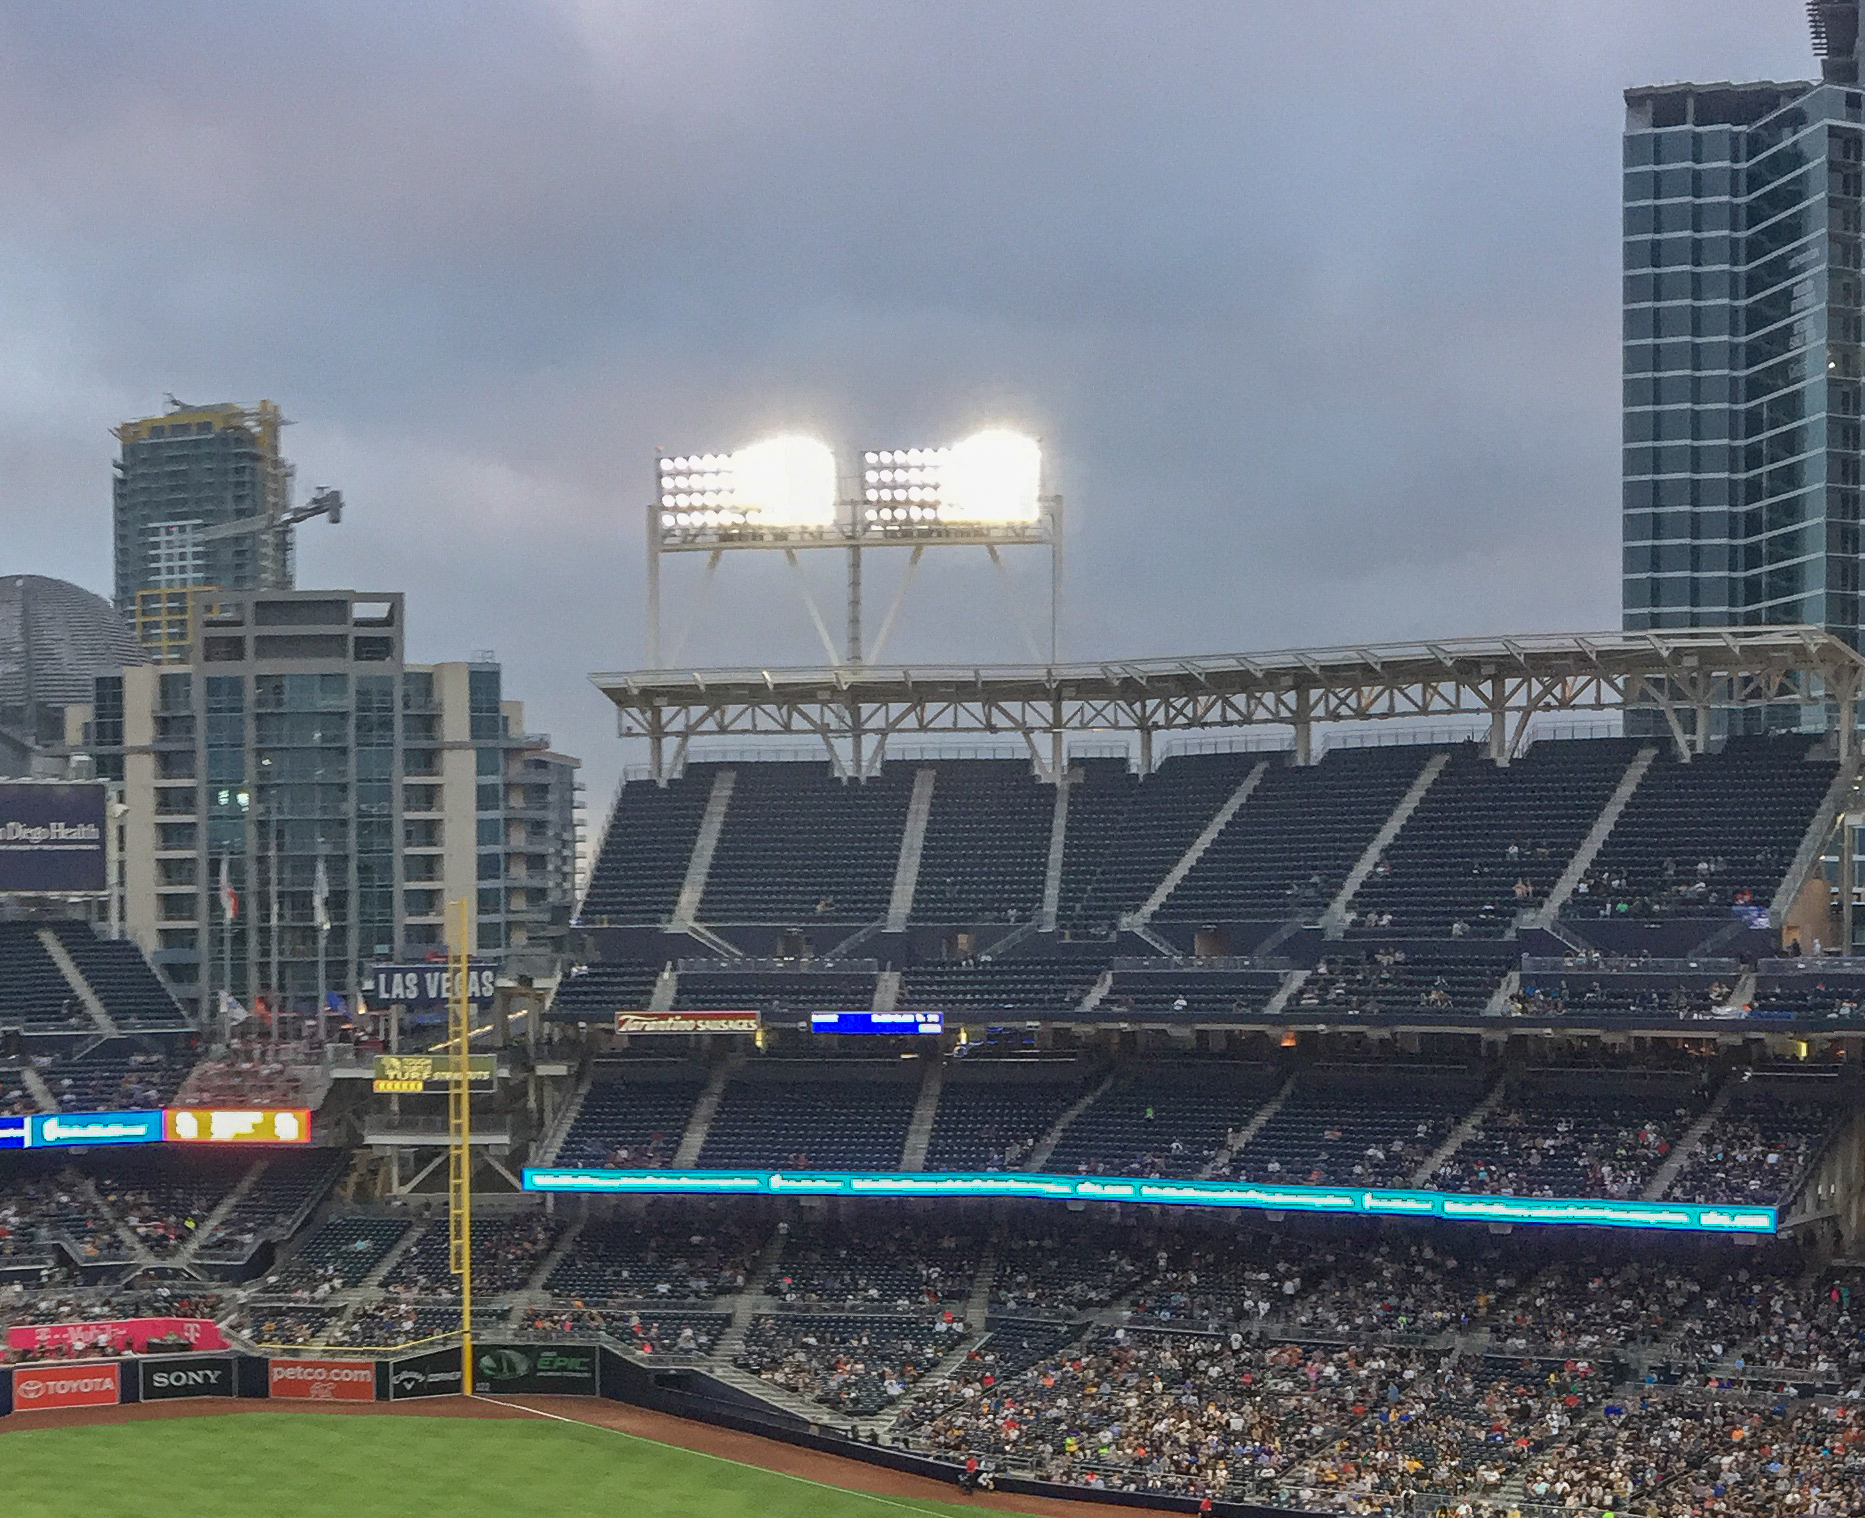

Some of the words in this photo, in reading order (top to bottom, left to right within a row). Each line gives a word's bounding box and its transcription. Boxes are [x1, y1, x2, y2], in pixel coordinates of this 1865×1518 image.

[6, 822, 48, 844] Diego
[49, 822, 99, 841] Health
[378, 973, 420, 999] LAS
[536, 1358, 590, 1371] EPIC
[152, 1370, 222, 1387] SONY
[272, 1366, 371, 1384] petco.com
[46, 1378, 114, 1394] TOYOTA
